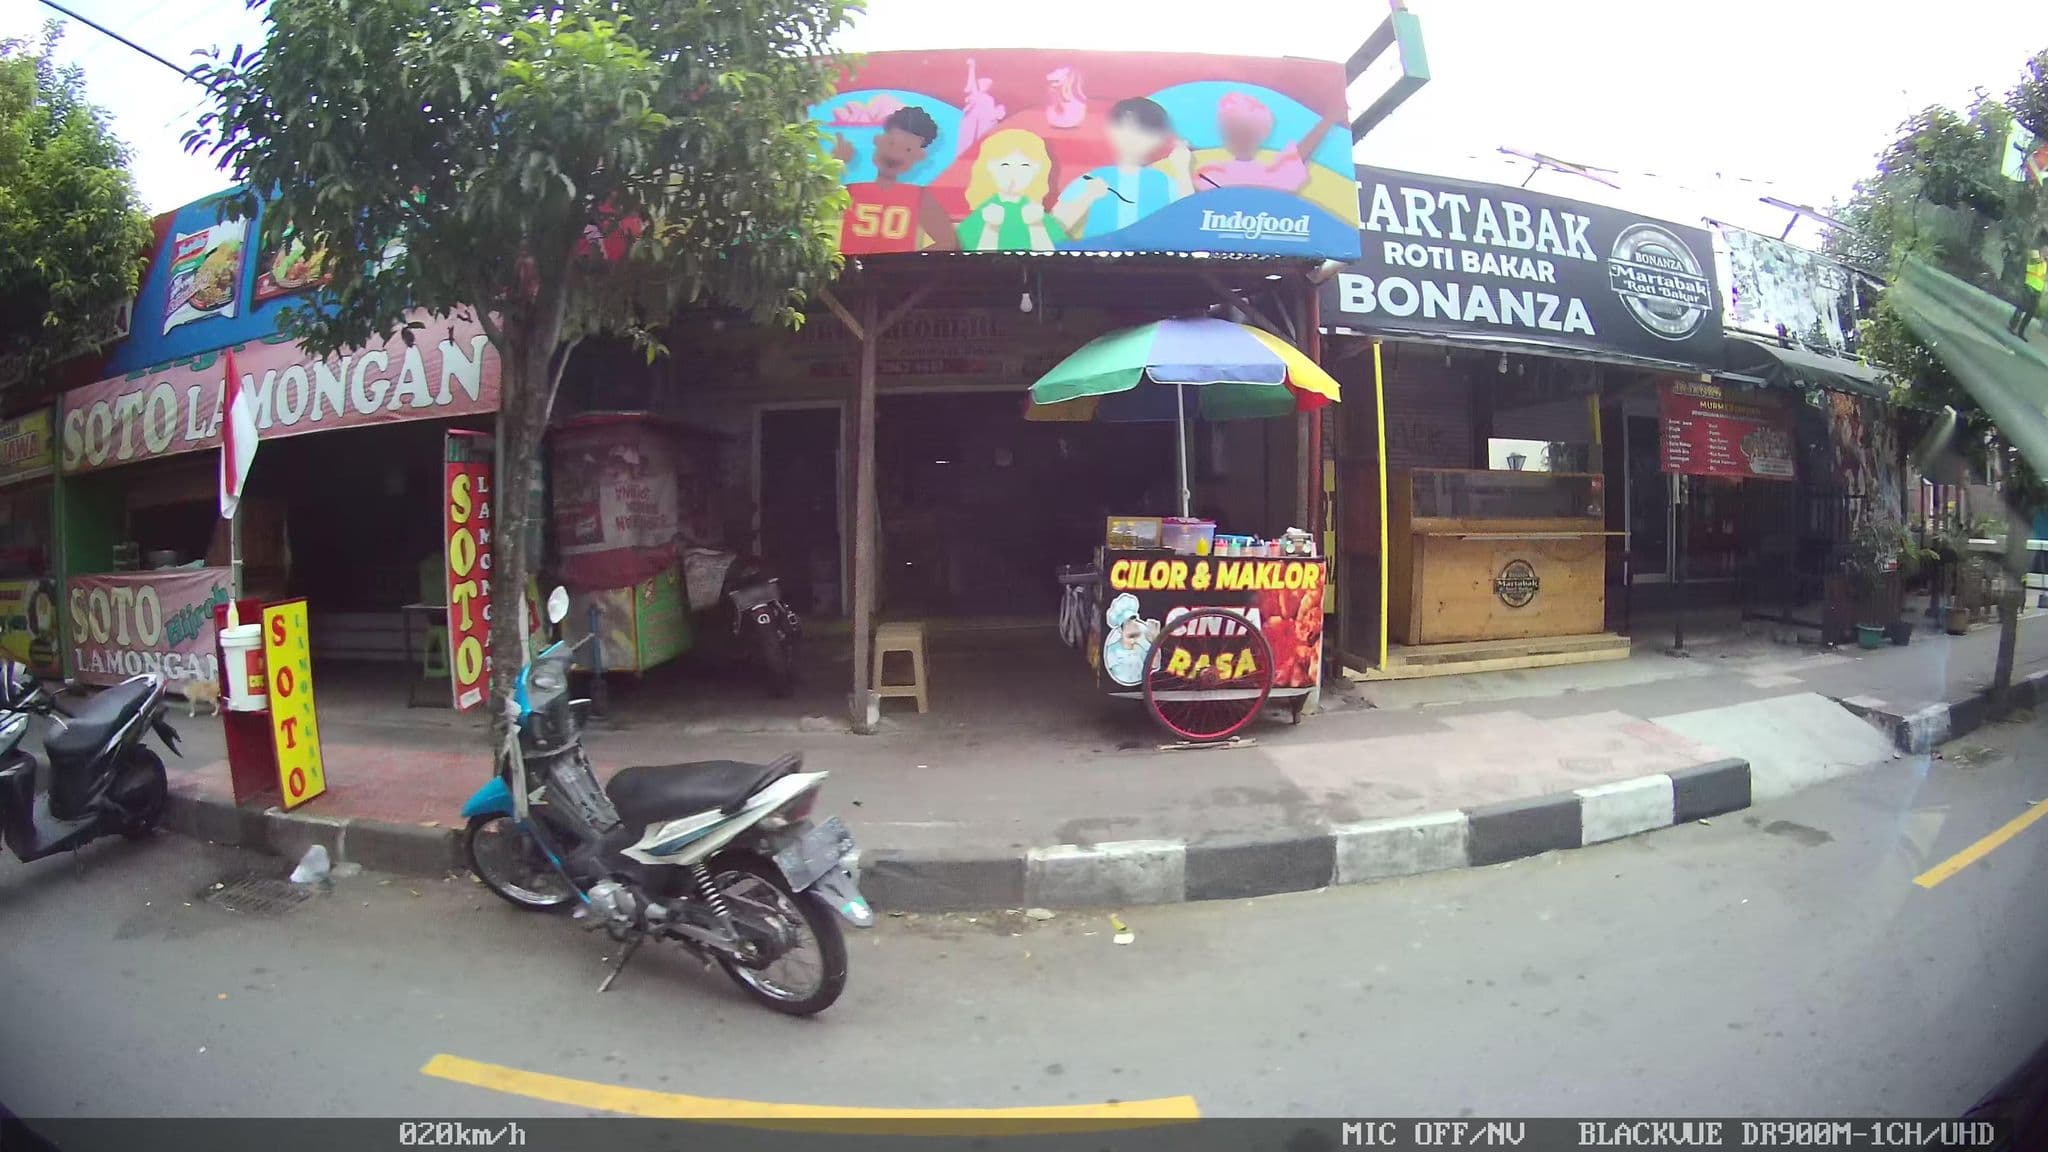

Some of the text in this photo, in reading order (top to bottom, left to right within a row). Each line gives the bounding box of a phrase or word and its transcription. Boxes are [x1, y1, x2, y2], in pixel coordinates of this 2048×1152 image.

[852, 203, 912, 240] 50
[1199, 209, 1311, 241] Indofood
[1359, 181, 1598, 262] ARTABAK
[1383, 241, 1556, 284] ROTI BAKAR
[1611, 264, 1708, 297] Martabak
[1634, 252, 1684, 272] BONANZA
[1337, 273, 1596, 336] BONANZA
[1623, 279, 1657, 294] Roti
[63, 382, 179, 468] SOTO
[450, 472, 484, 686] SOTO
[1109, 558, 1321, 592] CILOR & MAKLOR
[69, 584, 163, 648] SOTO
[1165, 605, 1263, 638] CINTA
[1166, 647, 1258, 681] RASA
[270, 614, 307, 798] SOTO
